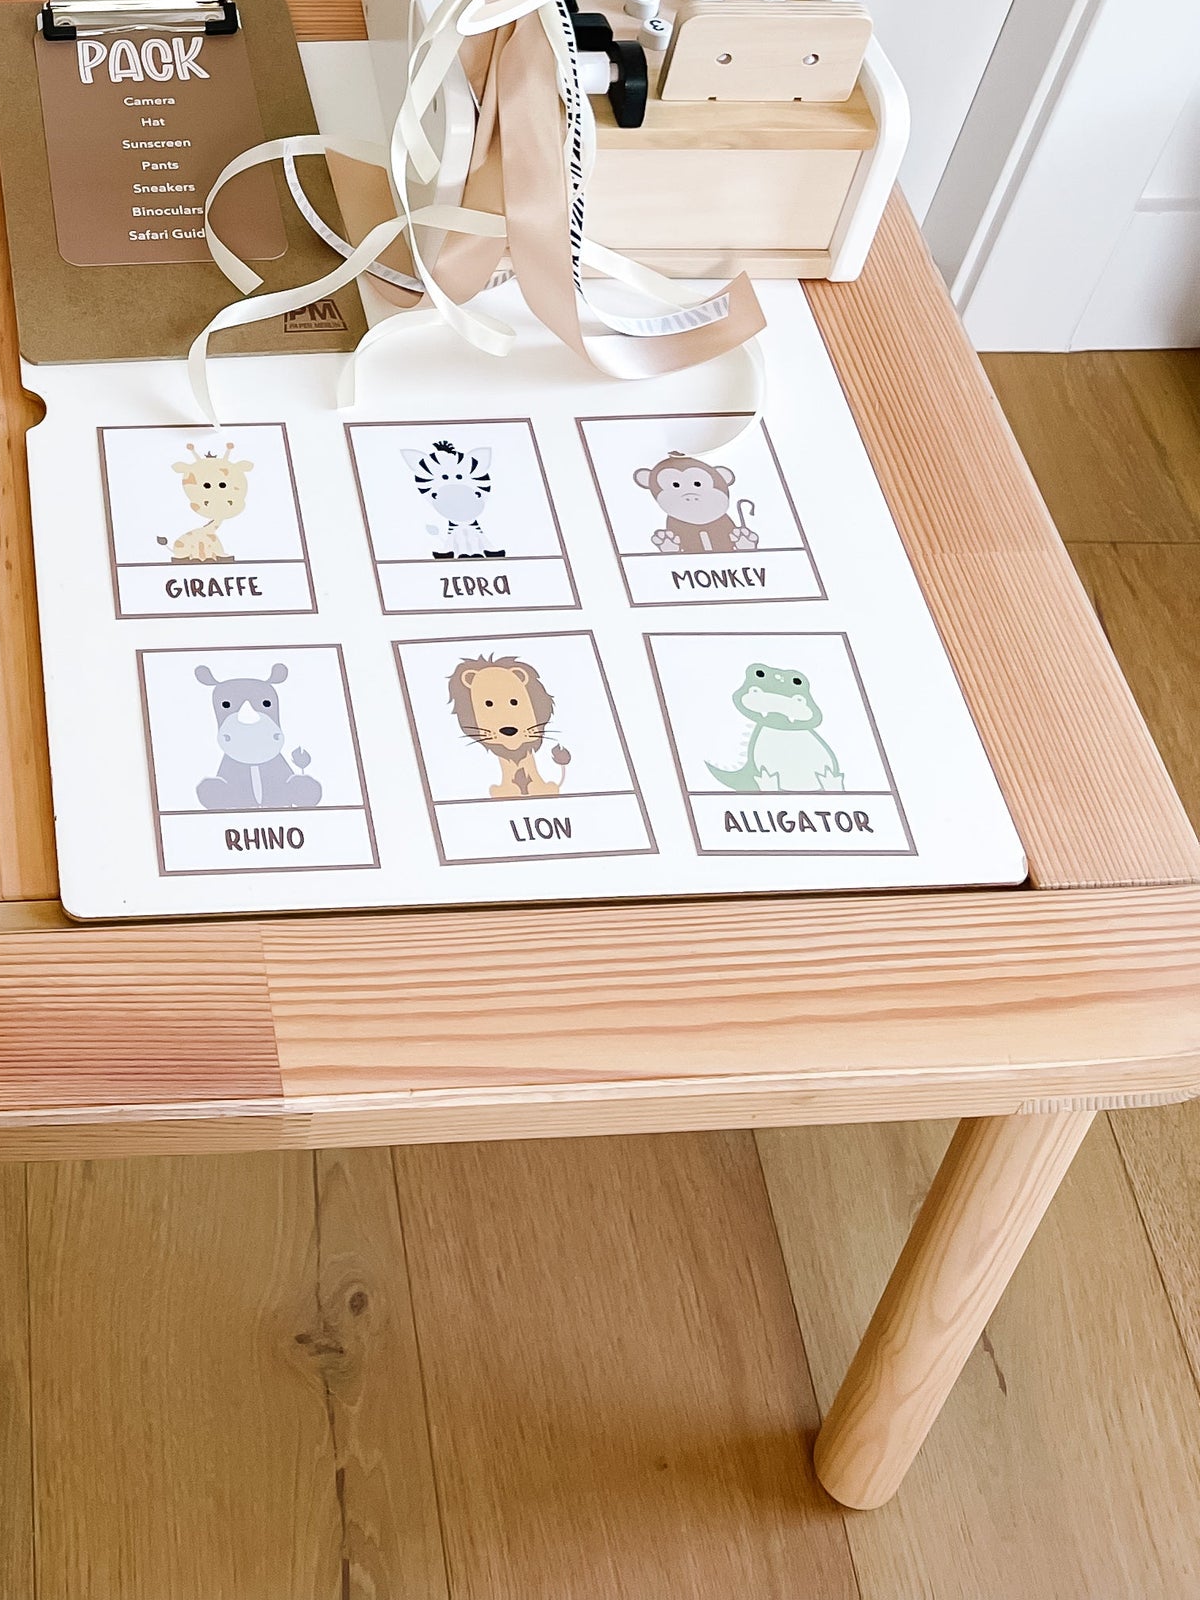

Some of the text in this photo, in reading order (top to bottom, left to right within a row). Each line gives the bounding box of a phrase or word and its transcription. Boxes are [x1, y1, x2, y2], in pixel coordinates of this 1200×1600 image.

[649, 19, 664, 32] 3
[76, 36, 211, 84] PACK
[123, 96, 176, 107] Camera
[140, 117, 166, 128] Hat
[121, 139, 191, 150] Sunscreen
[141, 161, 180, 171] Pants
[132, 182, 196, 194] Sneakers
[131, 205, 204, 217] Binoculars
[128, 228, 206, 241] Safari Guid
[289, 302, 338, 321] PM
[671, 567, 766, 590] MONKEY
[164, 574, 264, 599] GIRAFFE
[724, 809, 875, 835] ALLIGATOR
[509, 817, 573, 842] LION
[225, 826, 306, 852] RHINO
